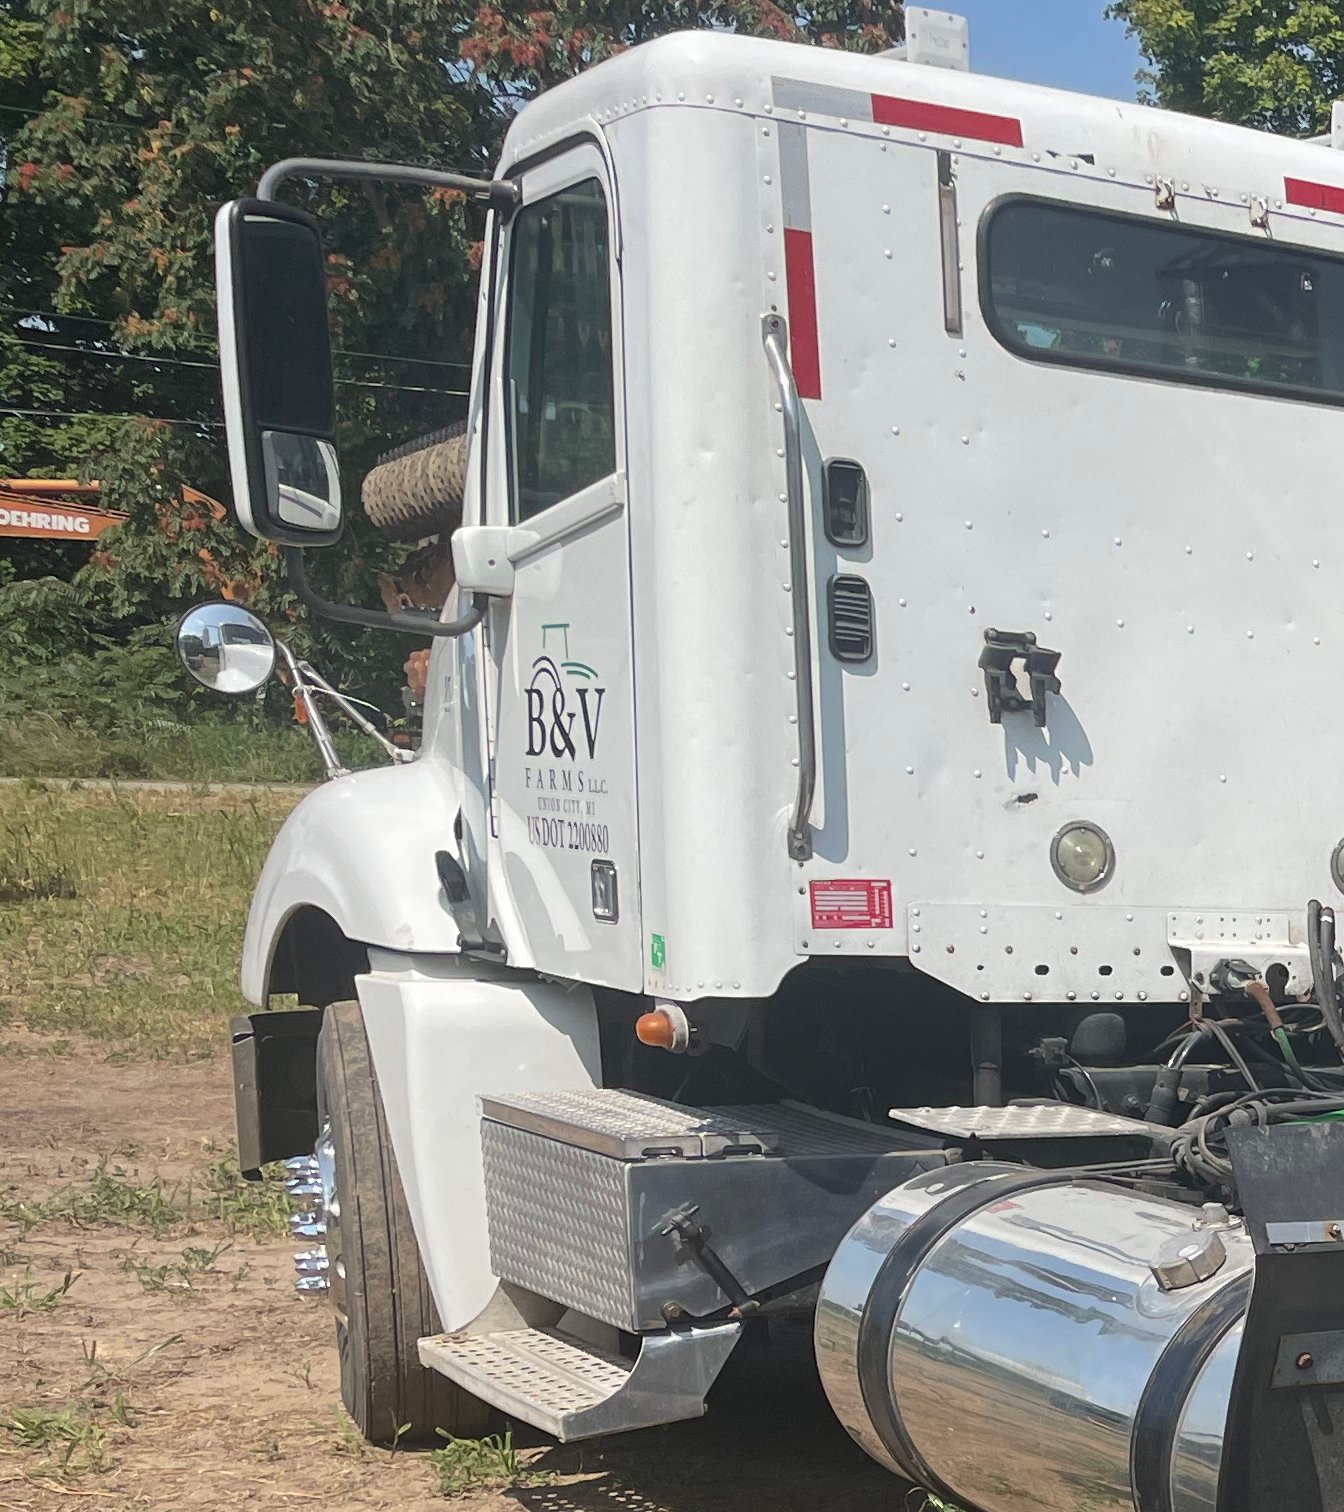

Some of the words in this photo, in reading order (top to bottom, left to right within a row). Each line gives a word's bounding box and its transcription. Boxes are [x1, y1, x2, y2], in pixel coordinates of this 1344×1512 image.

[525, 687, 606, 762] B&V
[525, 767, 584, 793] FARMS
[567, 820, 609, 854] 2200880
